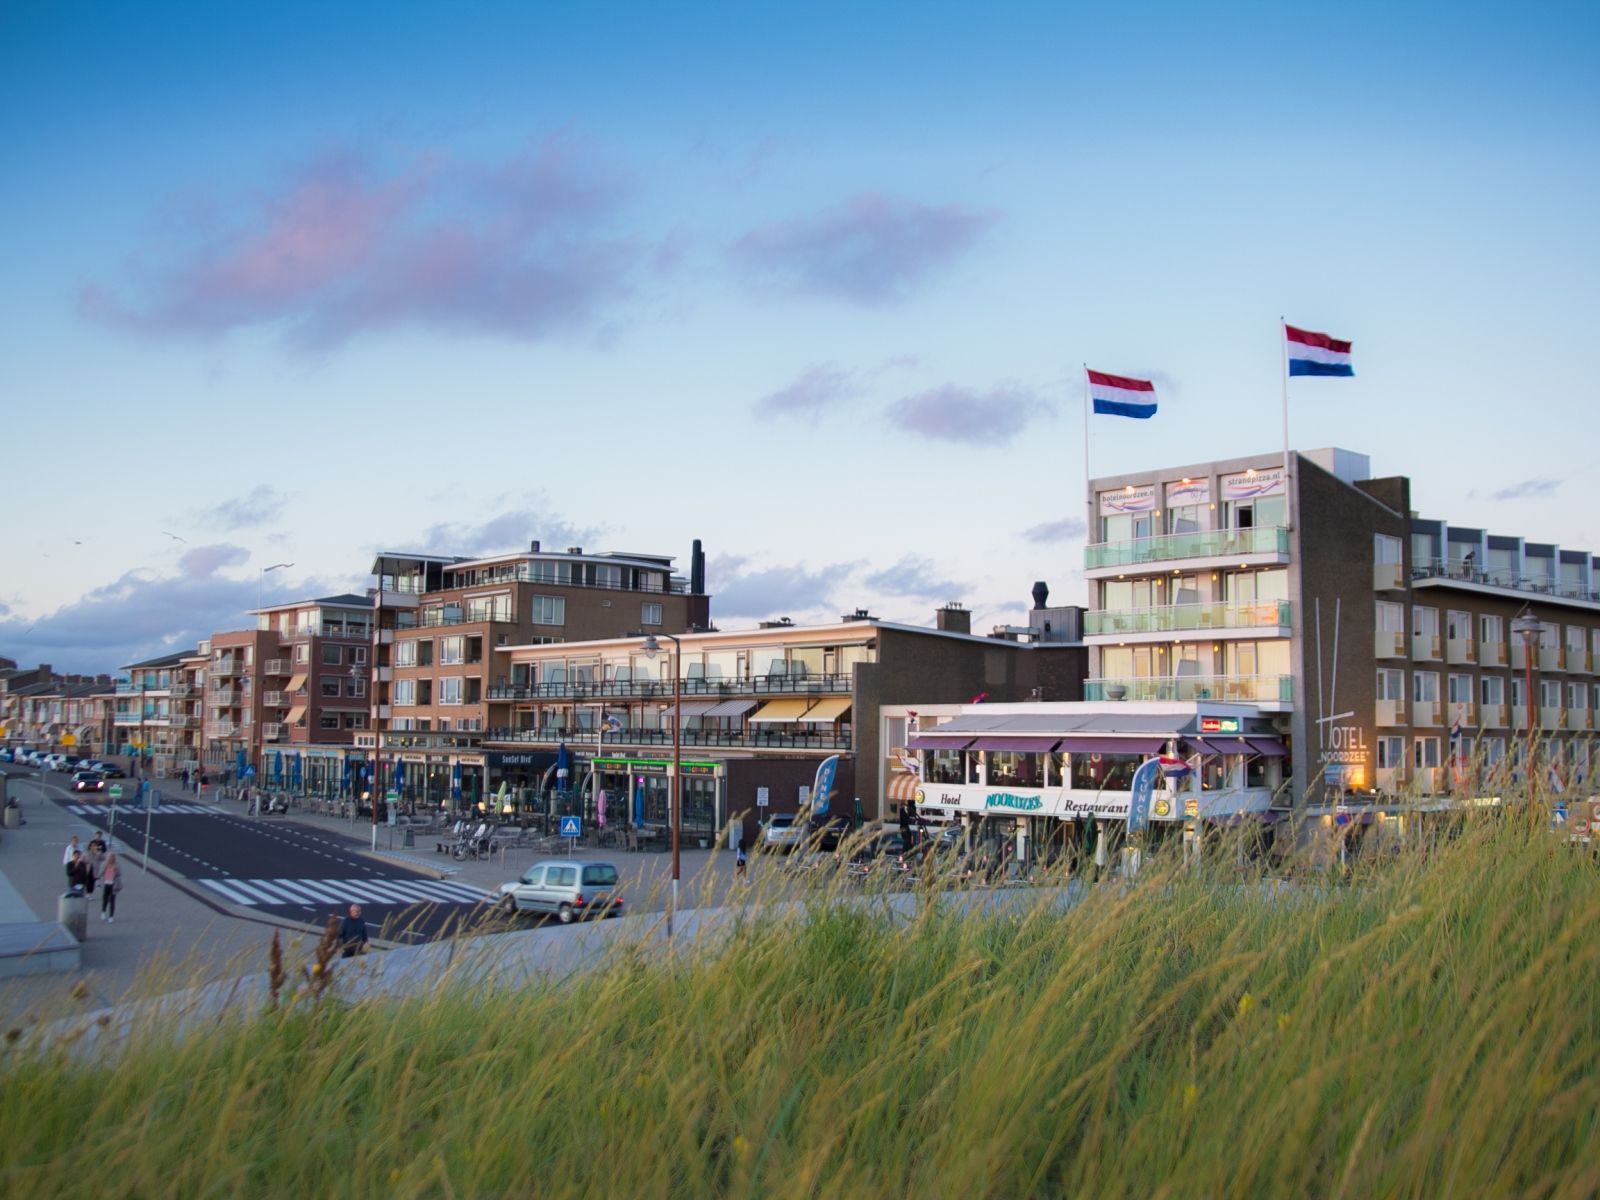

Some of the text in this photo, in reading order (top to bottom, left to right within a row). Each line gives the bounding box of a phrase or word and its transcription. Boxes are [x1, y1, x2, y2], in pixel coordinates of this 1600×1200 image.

[1228, 472, 1280, 487] strandpizza.nl
[1102, 490, 1154, 502] hotelnoordzee.n
[940, 791, 1129, 813] Hotel NOORDZEE Restaurant
[1135, 773, 1149, 823] LUNCH
